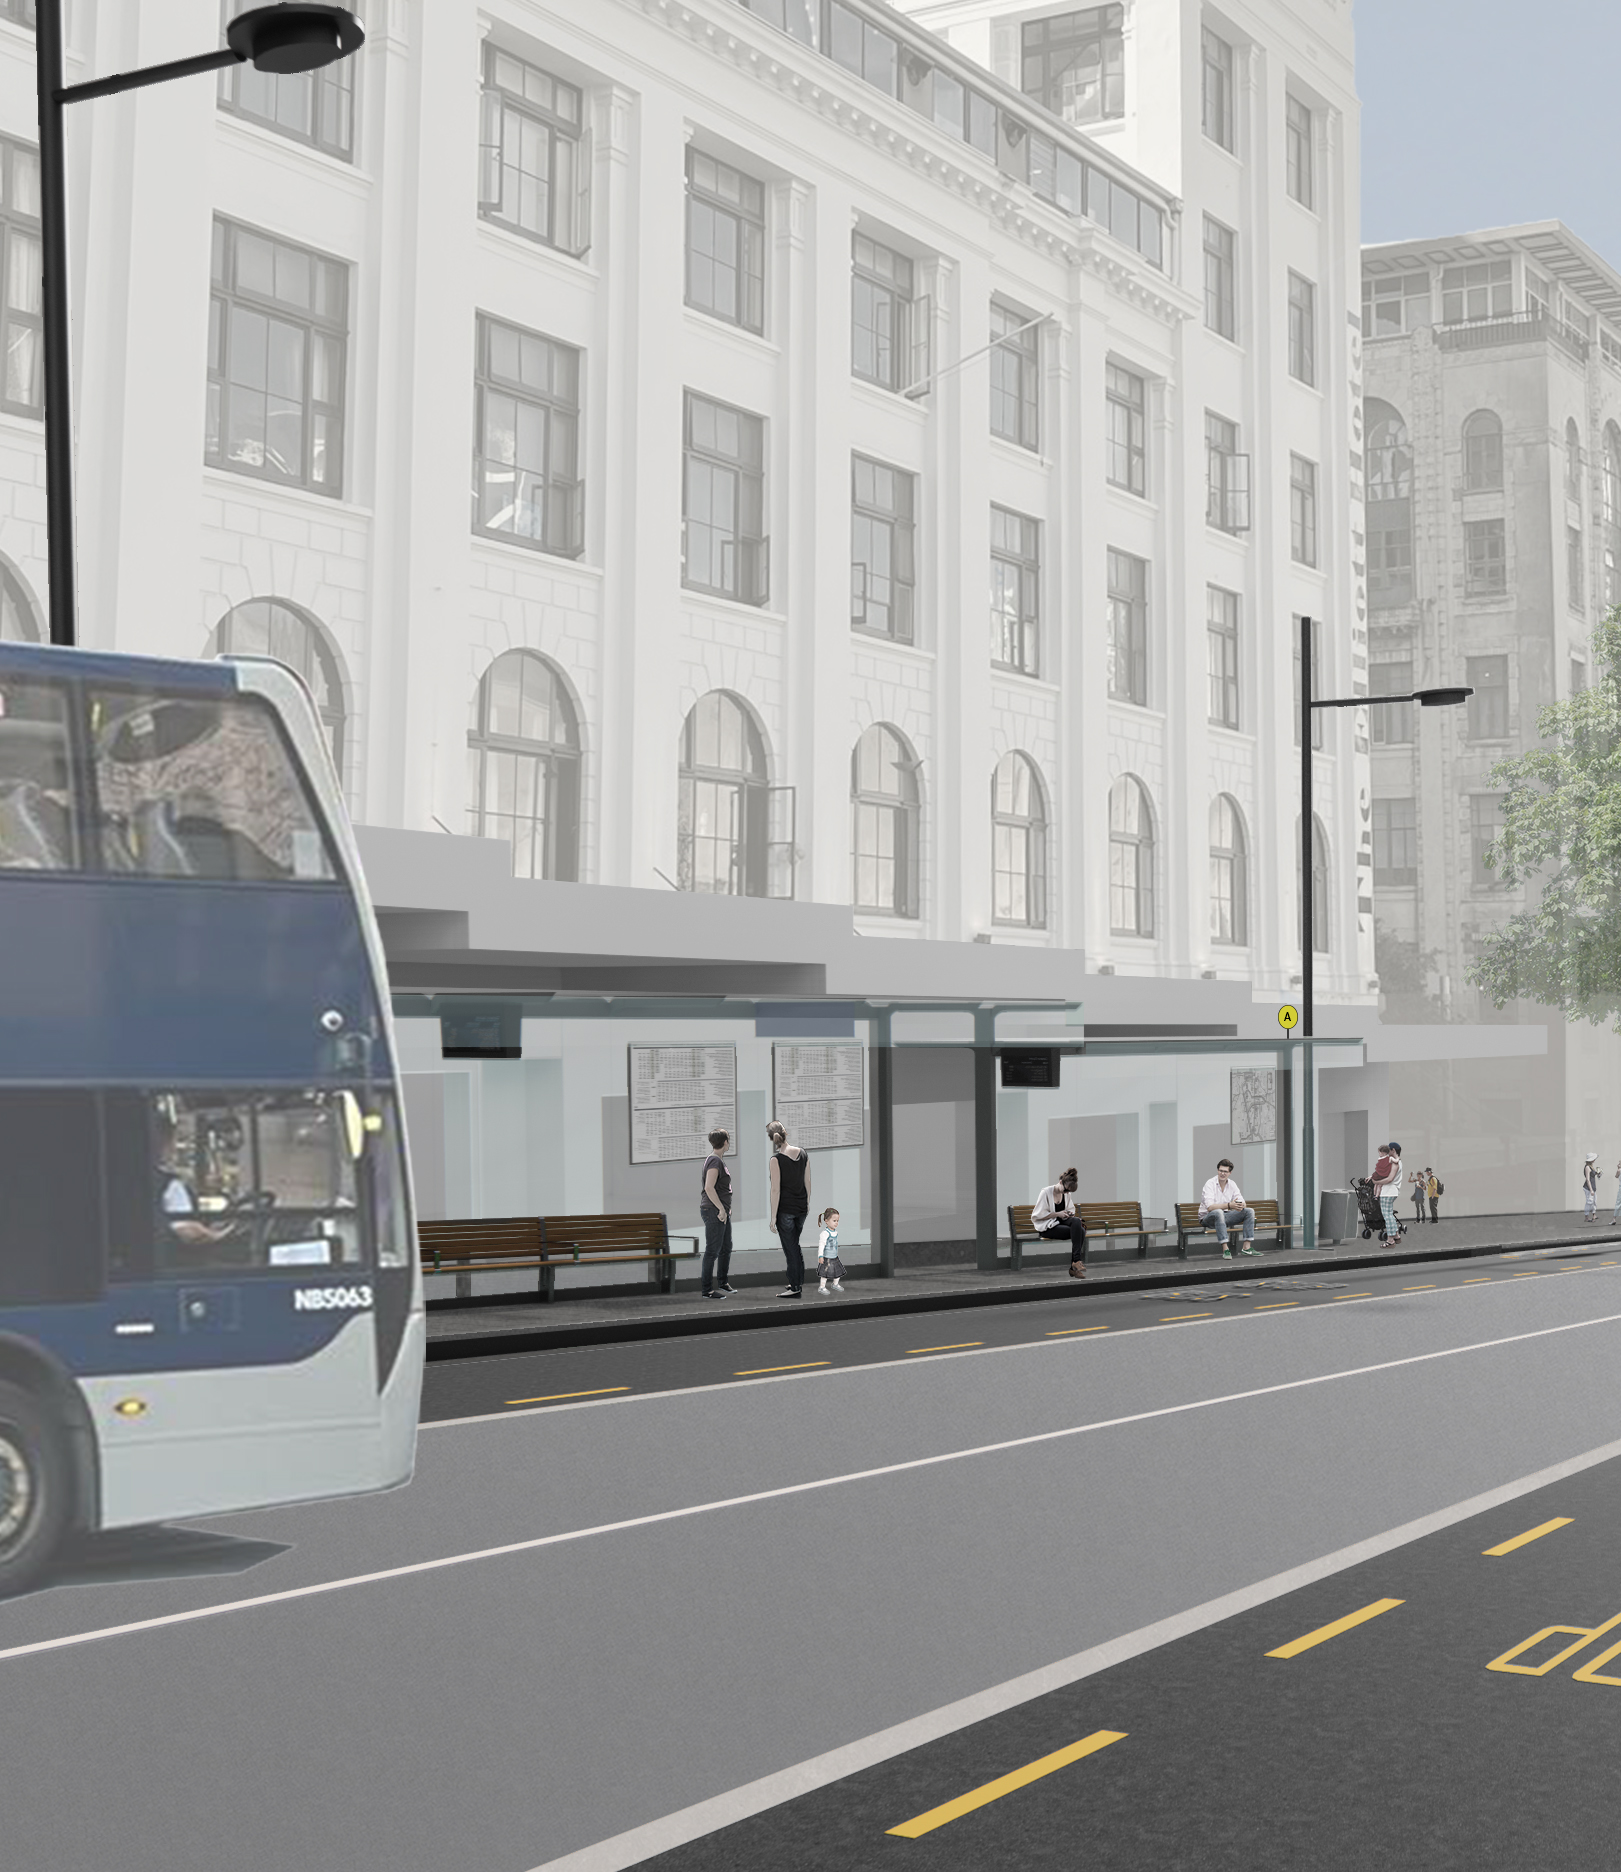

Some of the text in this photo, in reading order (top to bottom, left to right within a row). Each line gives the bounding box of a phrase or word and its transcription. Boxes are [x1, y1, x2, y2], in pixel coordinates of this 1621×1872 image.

[1347, 310, 1372, 933] The Elliott Hotel
[1283, 1011, 1292, 1022] A
